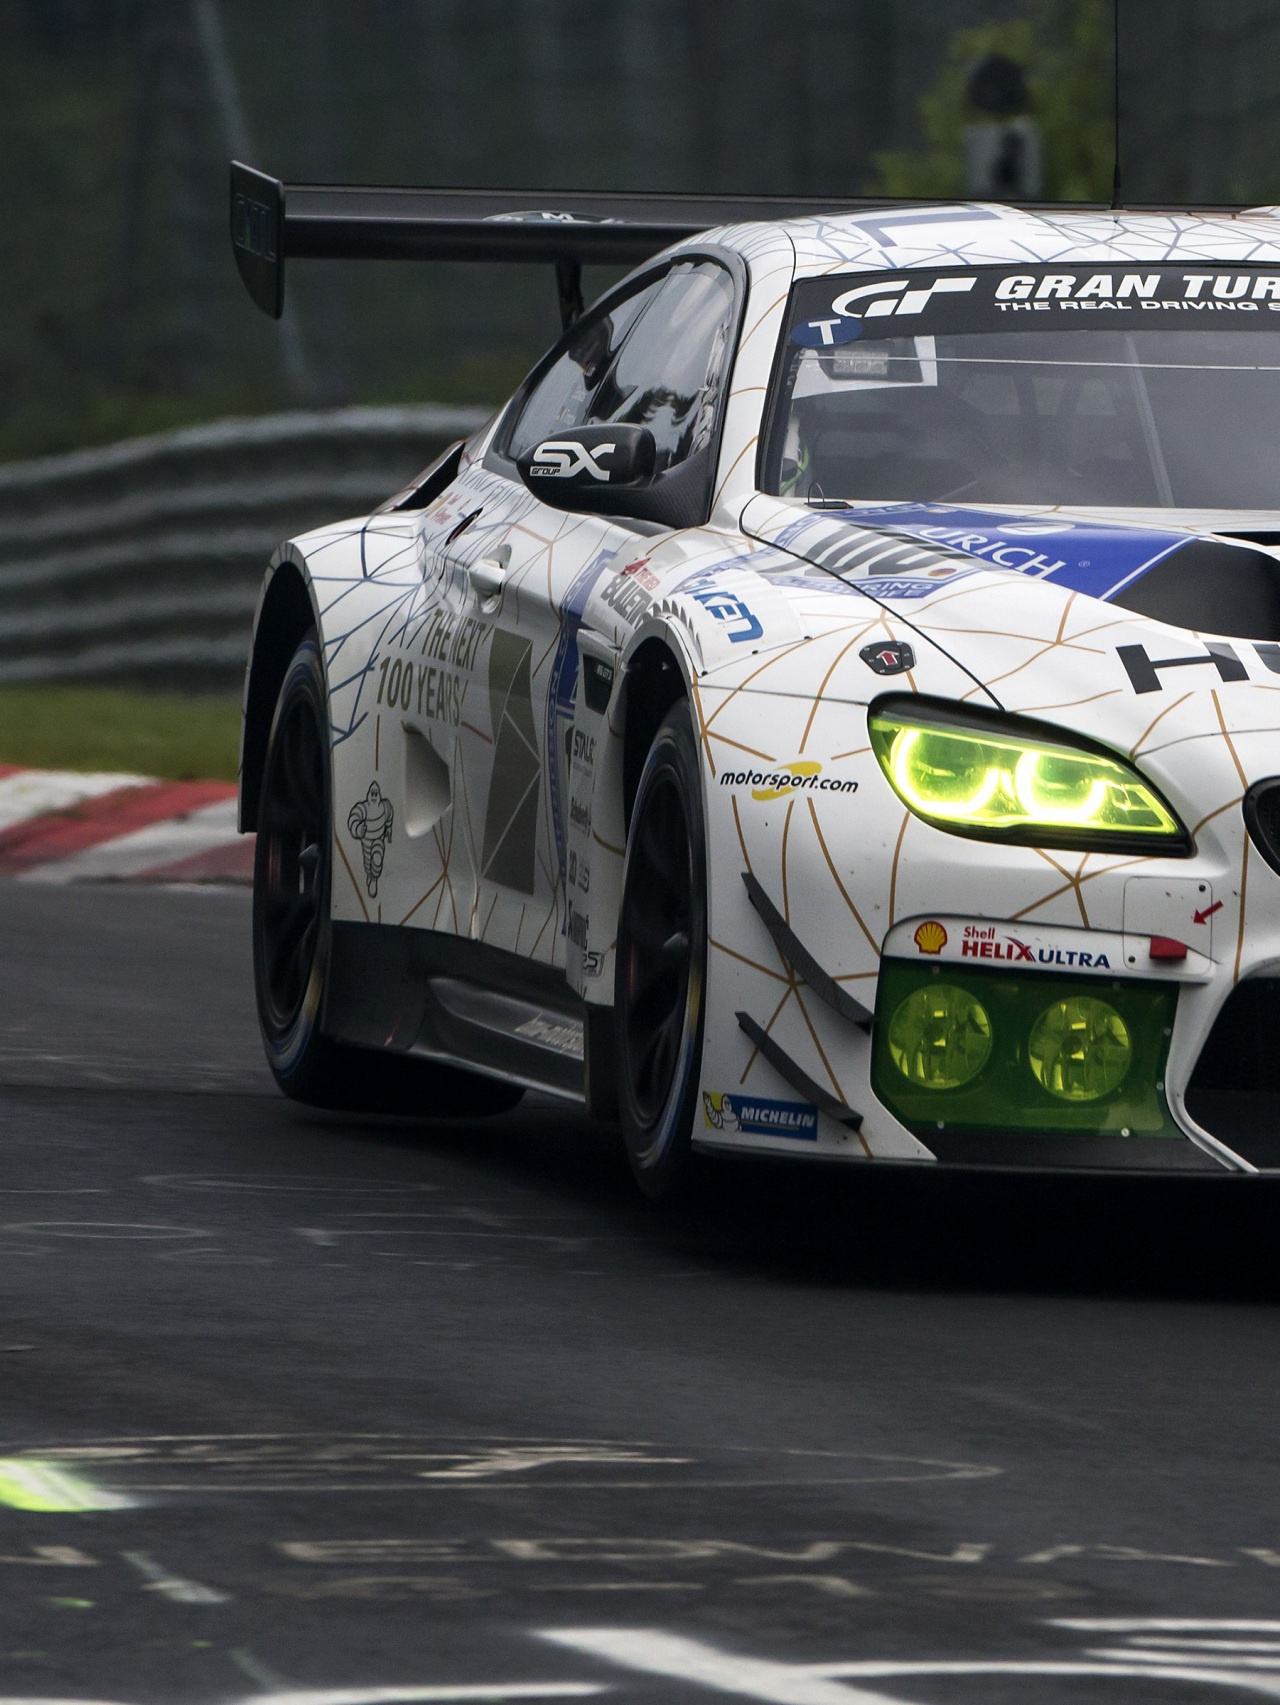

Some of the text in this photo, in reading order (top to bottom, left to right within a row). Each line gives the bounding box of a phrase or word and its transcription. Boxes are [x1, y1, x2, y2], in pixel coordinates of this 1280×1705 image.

[995, 274, 1161, 299] GRAN
[994, 301, 1051, 311] THE
[1060, 301, 1132, 310] REAL
[1140, 301, 1259, 311] DRIVING
[808, 319, 842, 346] T
[914, 526, 1067, 581] URICH
[376, 656, 461, 727] 100 YEARS
[720, 770, 859, 793] motorsport.com
[963, 926, 996, 940] Shell
[962, 936, 1111, 969] HELIX ULTRA
[741, 1106, 815, 1128] MICHELIN
